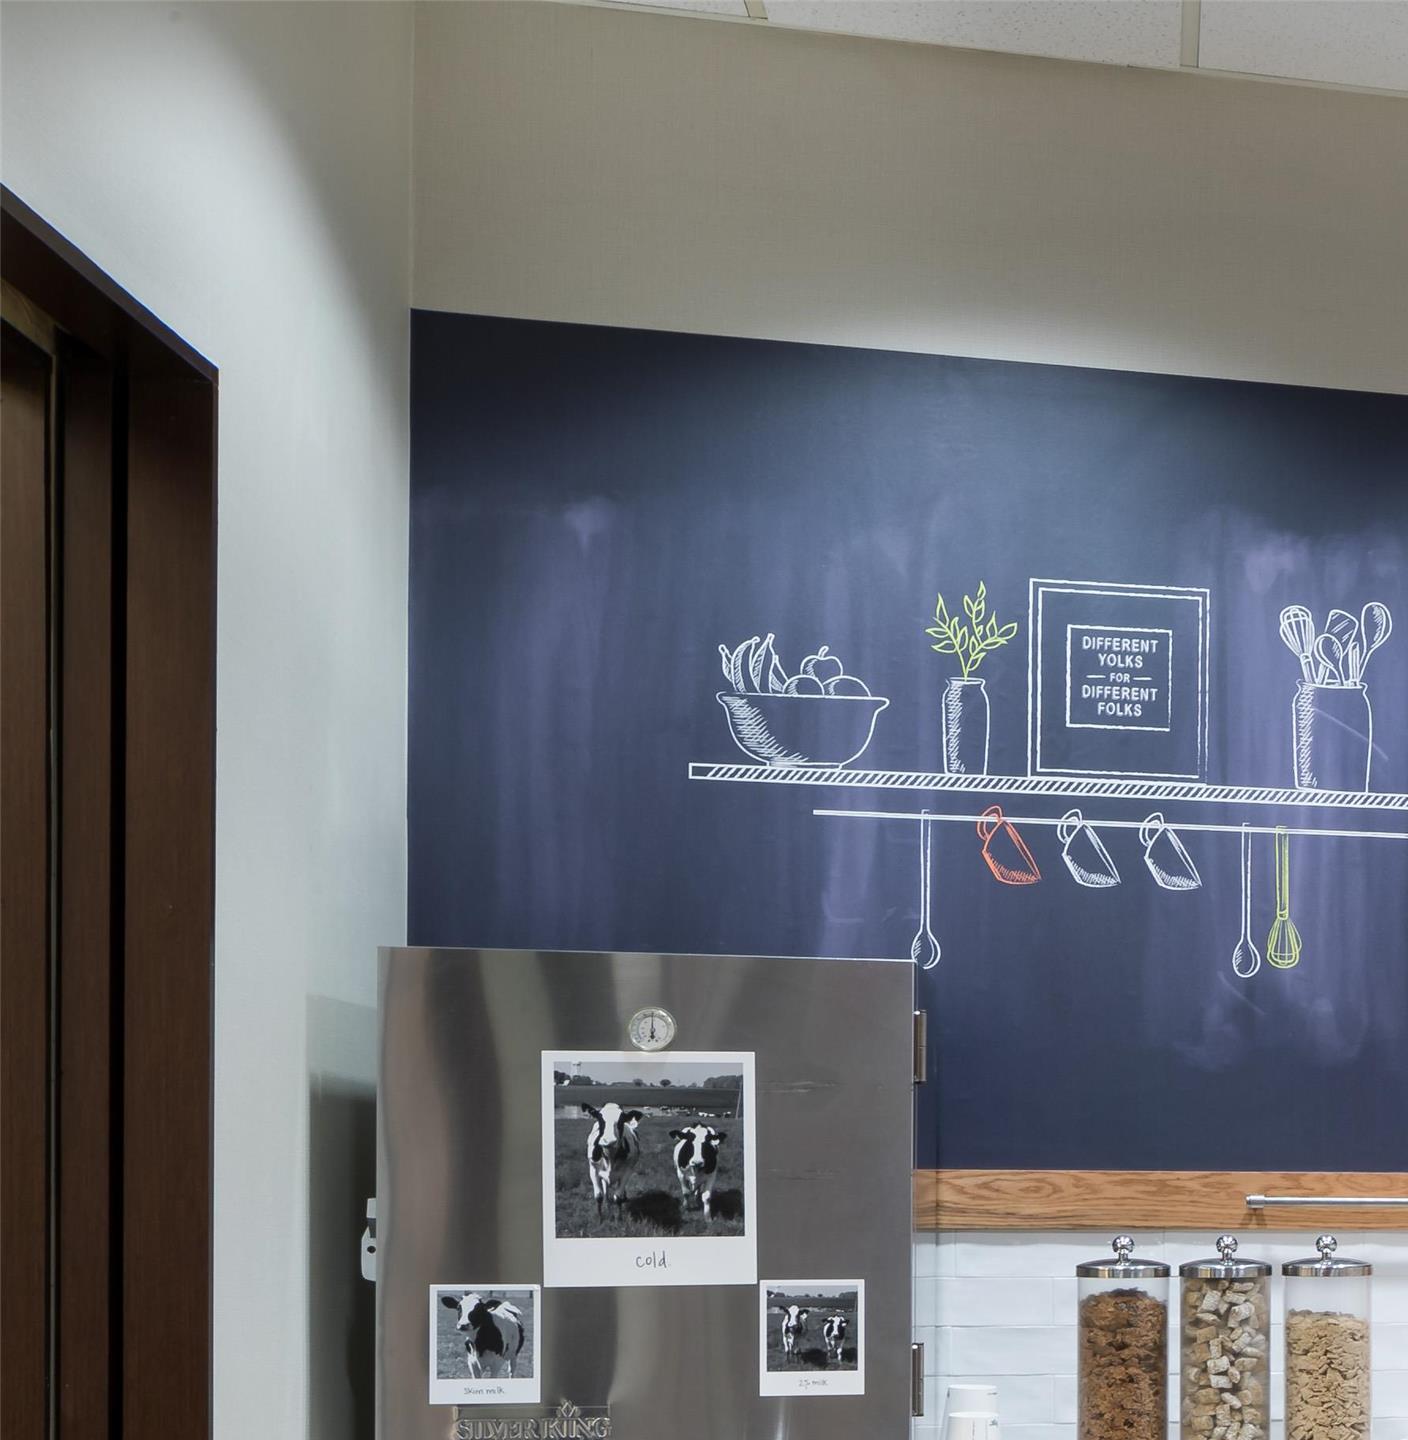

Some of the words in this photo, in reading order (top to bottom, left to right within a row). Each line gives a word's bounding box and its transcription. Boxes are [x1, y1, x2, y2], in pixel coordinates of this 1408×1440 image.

[1082, 636, 1158, 653] DIFFERENT
[1098, 654, 1143, 669] YOLKS
[1110, 673, 1130, 683] FOR
[1082, 685, 1158, 701] DIFFERENT
[1098, 702, 1142, 717] FOLKS
[636, 1251, 667, 1268] cold
[456, 1419, 541, 1440] SILVER
[543, 1418, 611, 1439] KING
